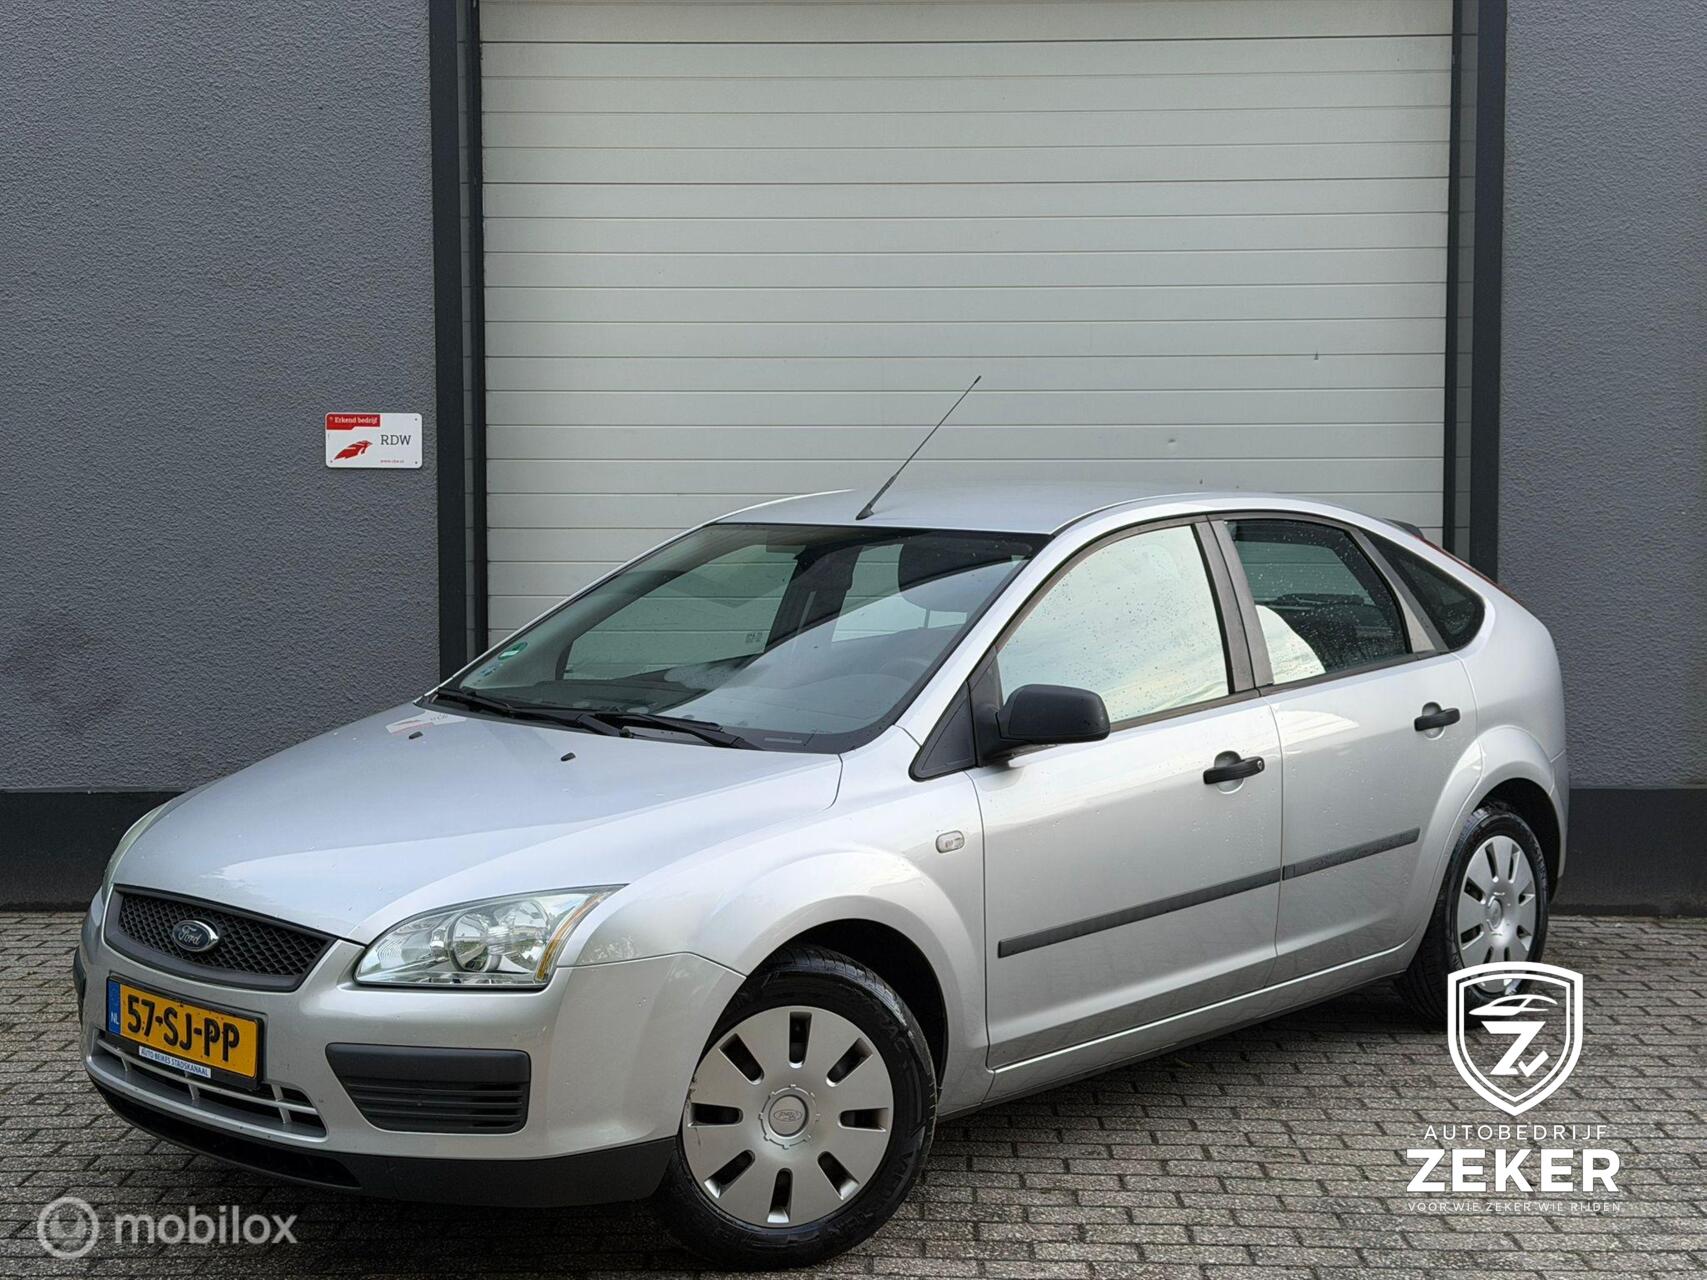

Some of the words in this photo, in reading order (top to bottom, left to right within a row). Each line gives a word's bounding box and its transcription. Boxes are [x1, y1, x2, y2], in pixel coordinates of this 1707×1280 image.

[334, 416, 357, 424] Erkend
[358, 416, 378, 425] bedrijf
[380, 434, 412, 446] RDW
[178, 925, 203, 946] Ford
[110, 1011, 120, 1025] NL
[127, 994, 240, 1063] 57-SJ-PP
[141, 1048, 154, 1059] AUTO
